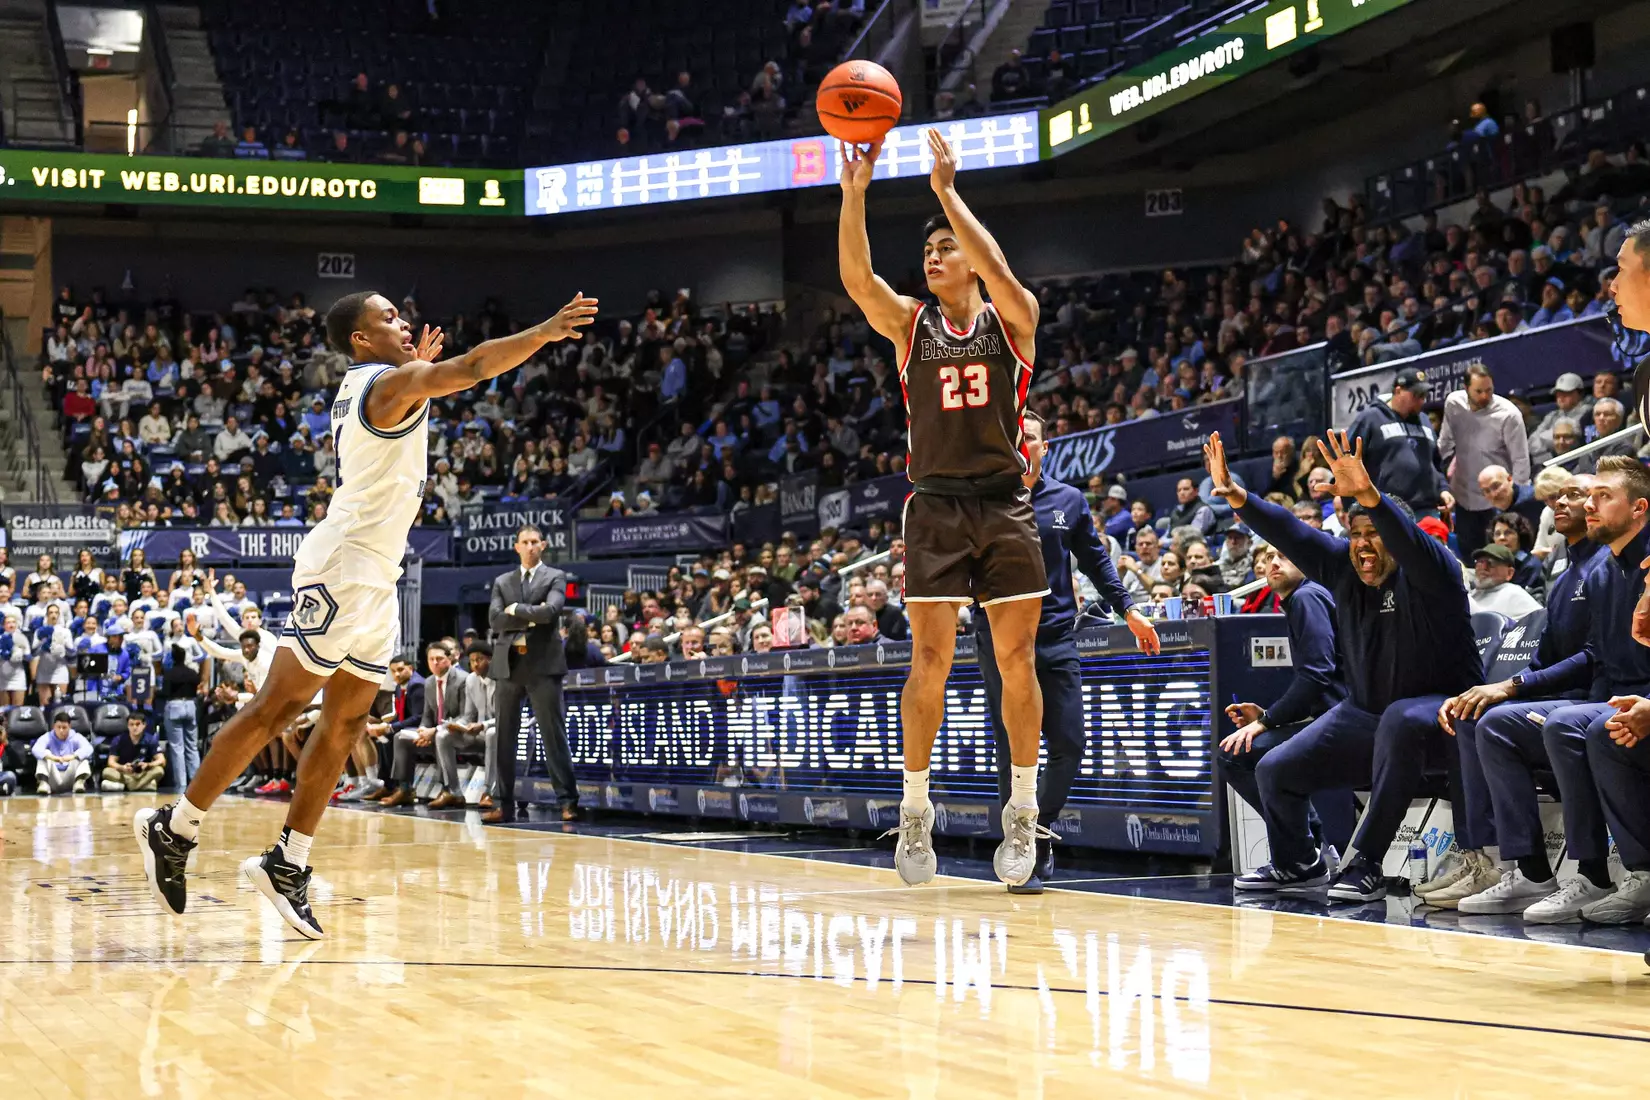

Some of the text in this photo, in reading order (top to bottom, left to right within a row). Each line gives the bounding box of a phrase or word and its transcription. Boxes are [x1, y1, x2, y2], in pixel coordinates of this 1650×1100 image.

[1108, 36, 1245, 116] WEB.URI.EDU/ROTC
[31, 165, 106, 189] VISIT
[120, 169, 377, 199] WEB.URI.EDU/ROTC
[318, 256, 353, 276] 202
[920, 333, 1001, 361] BROWN
[1424, 365, 1450, 379] SOUTH
[938, 362, 990, 411] 23
[1043, 429, 1118, 482] UCKUS
[468, 509, 564, 531] MATUNUCK
[13, 545, 46, 555] WATER
[53, 545, 73, 555] FIRE
[238, 533, 309, 557] THE RHO
[466, 531, 566, 553] OYSTE AR
[1496, 652, 1532, 661] MEDICAL
[136, 681, 145, 694] 3
[620, 700, 715, 766] ISLAND
[726, 692, 906, 769] MEDICAL
